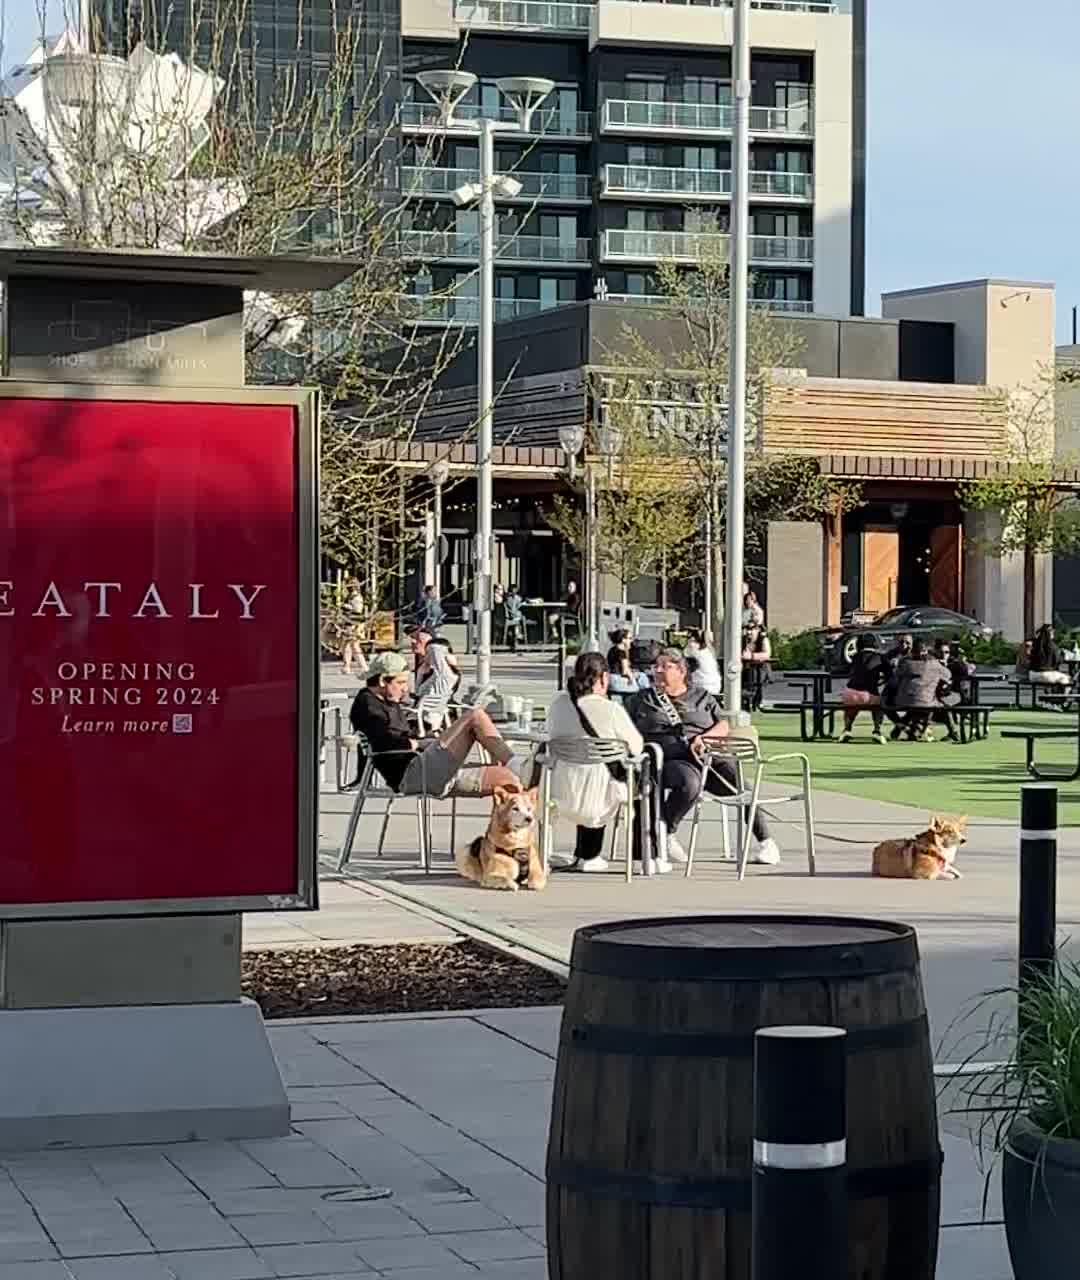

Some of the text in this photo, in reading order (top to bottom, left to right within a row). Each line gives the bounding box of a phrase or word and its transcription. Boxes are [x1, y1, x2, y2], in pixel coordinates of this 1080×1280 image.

[57, 662, 196, 681] OPENING
[31, 687, 220, 705] SPRING 2024
[61, 715, 169, 733] Learn more
